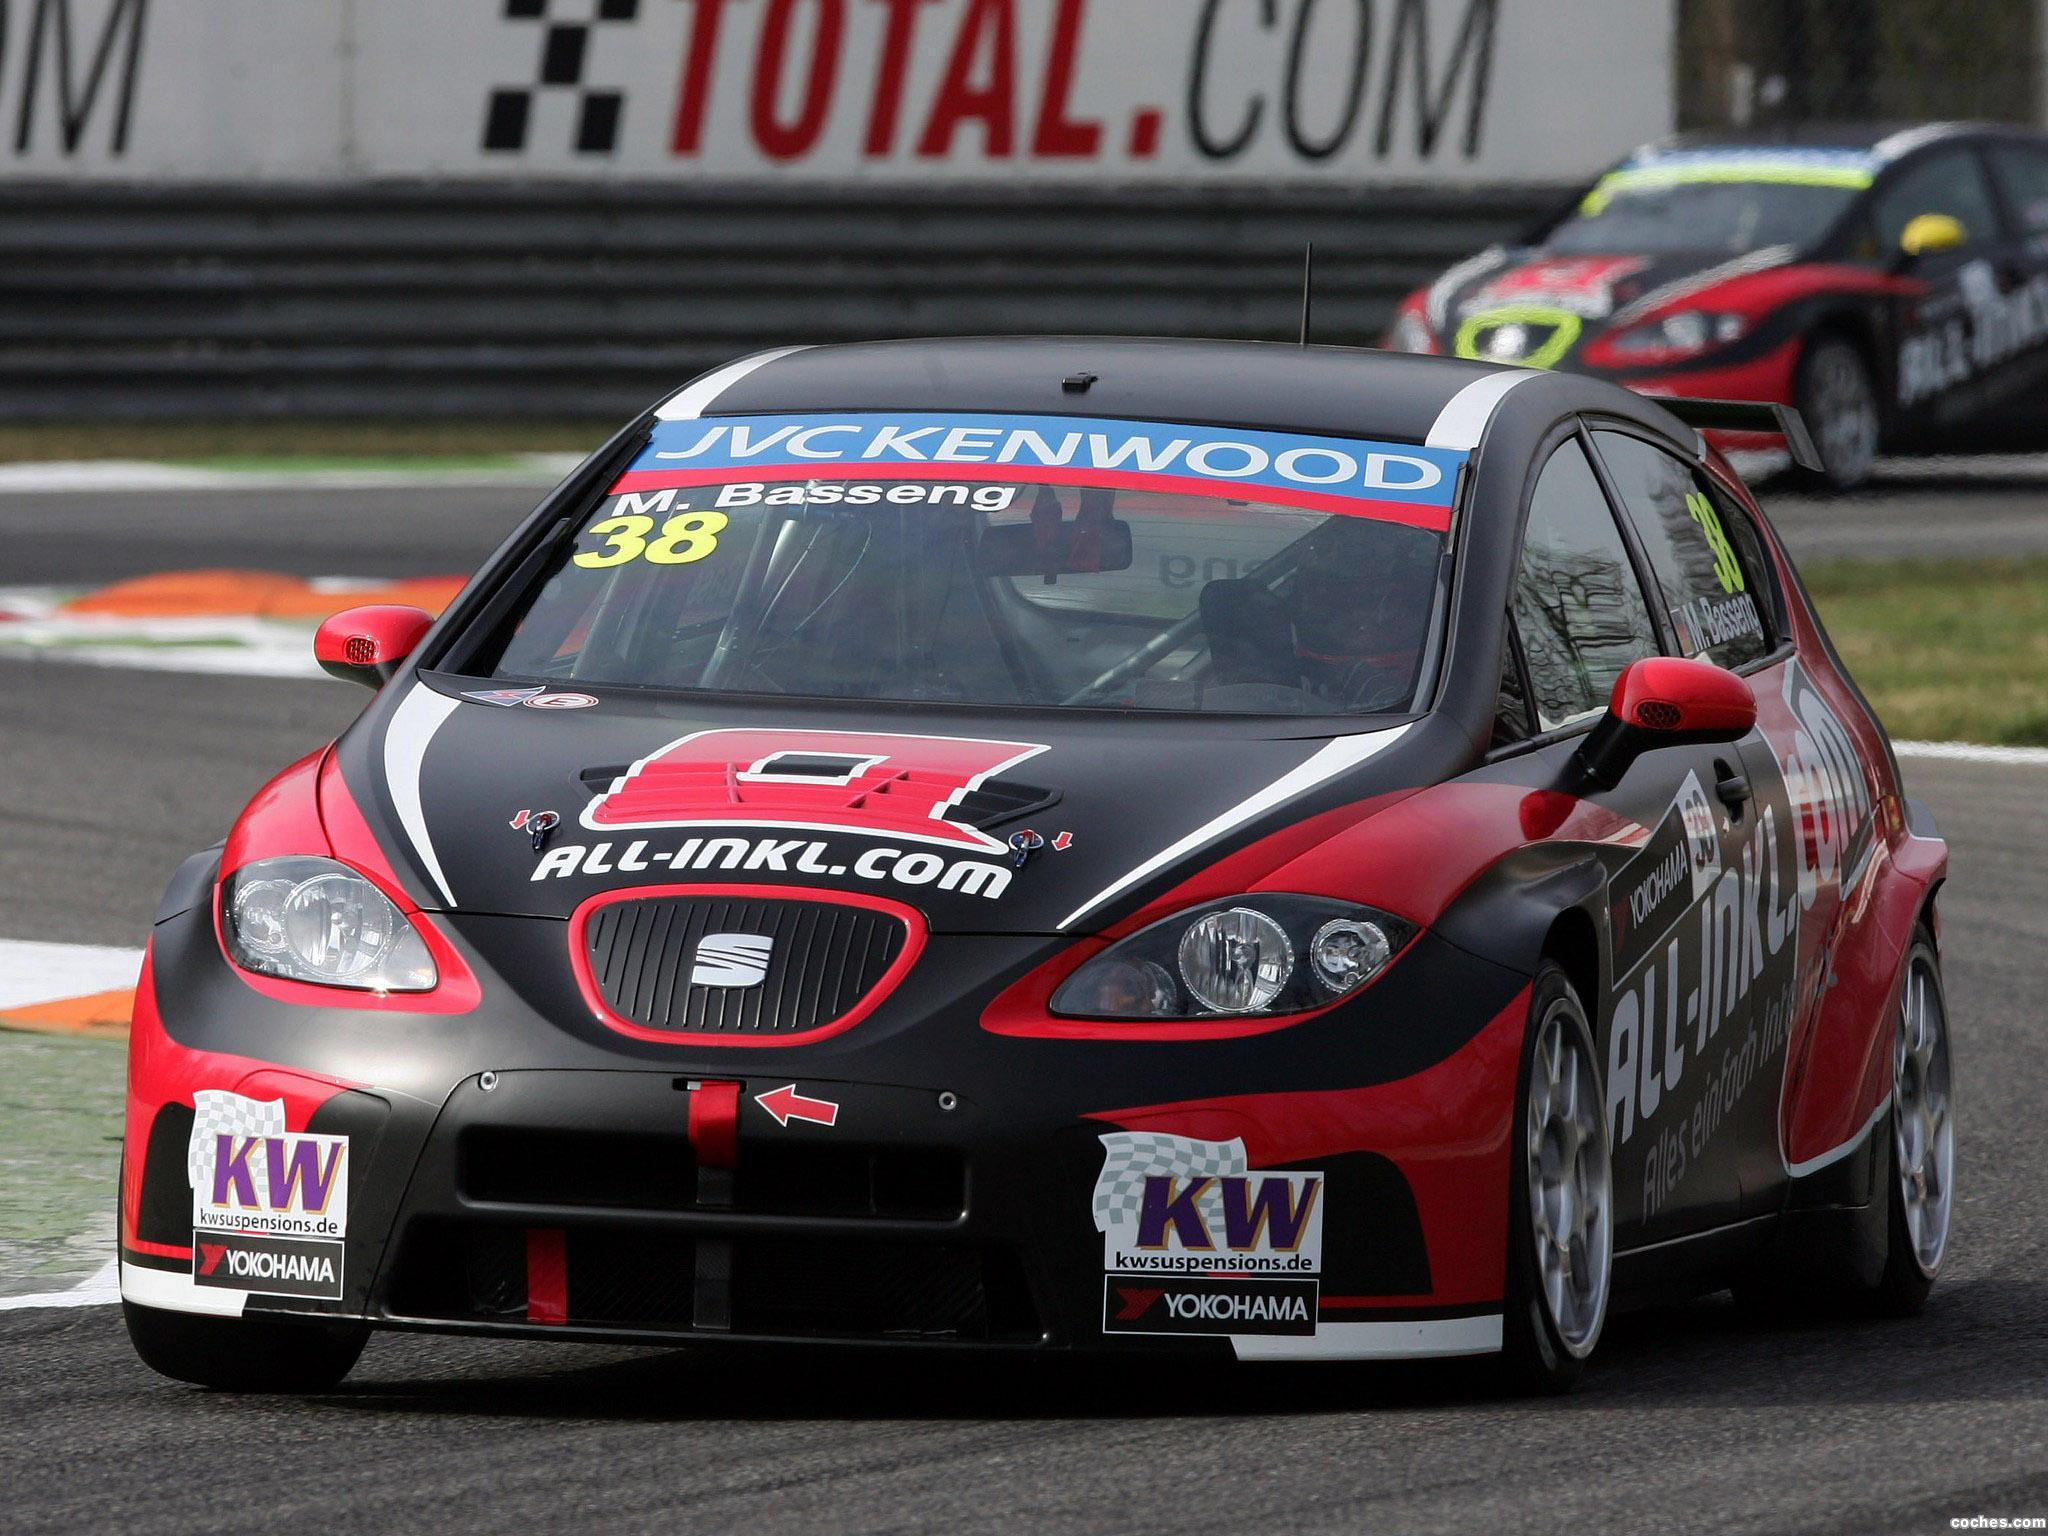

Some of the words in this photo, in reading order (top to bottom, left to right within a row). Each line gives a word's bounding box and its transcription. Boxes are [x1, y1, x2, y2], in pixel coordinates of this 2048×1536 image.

[611, 488, 694, 517] M.
[714, 481, 1017, 512] Basseng
[573, 510, 730, 570] 38
[1685, 491, 1745, 594] 38
[1699, 591, 1765, 645] Basseng
[1629, 840, 1689, 930] YOKOHAMA
[212, 1134, 347, 1216] KW
[1642, 1118, 1688, 1226] Alles
[200, 1208, 338, 1234] kwsuspensions.de
[1136, 1175, 1322, 1252] KW
[226, 1250, 335, 1283] YOKOHAMA
[1115, 1251, 1313, 1273] kwsuspensions.de
[1164, 1293, 1309, 1321] YOKOHAMA
